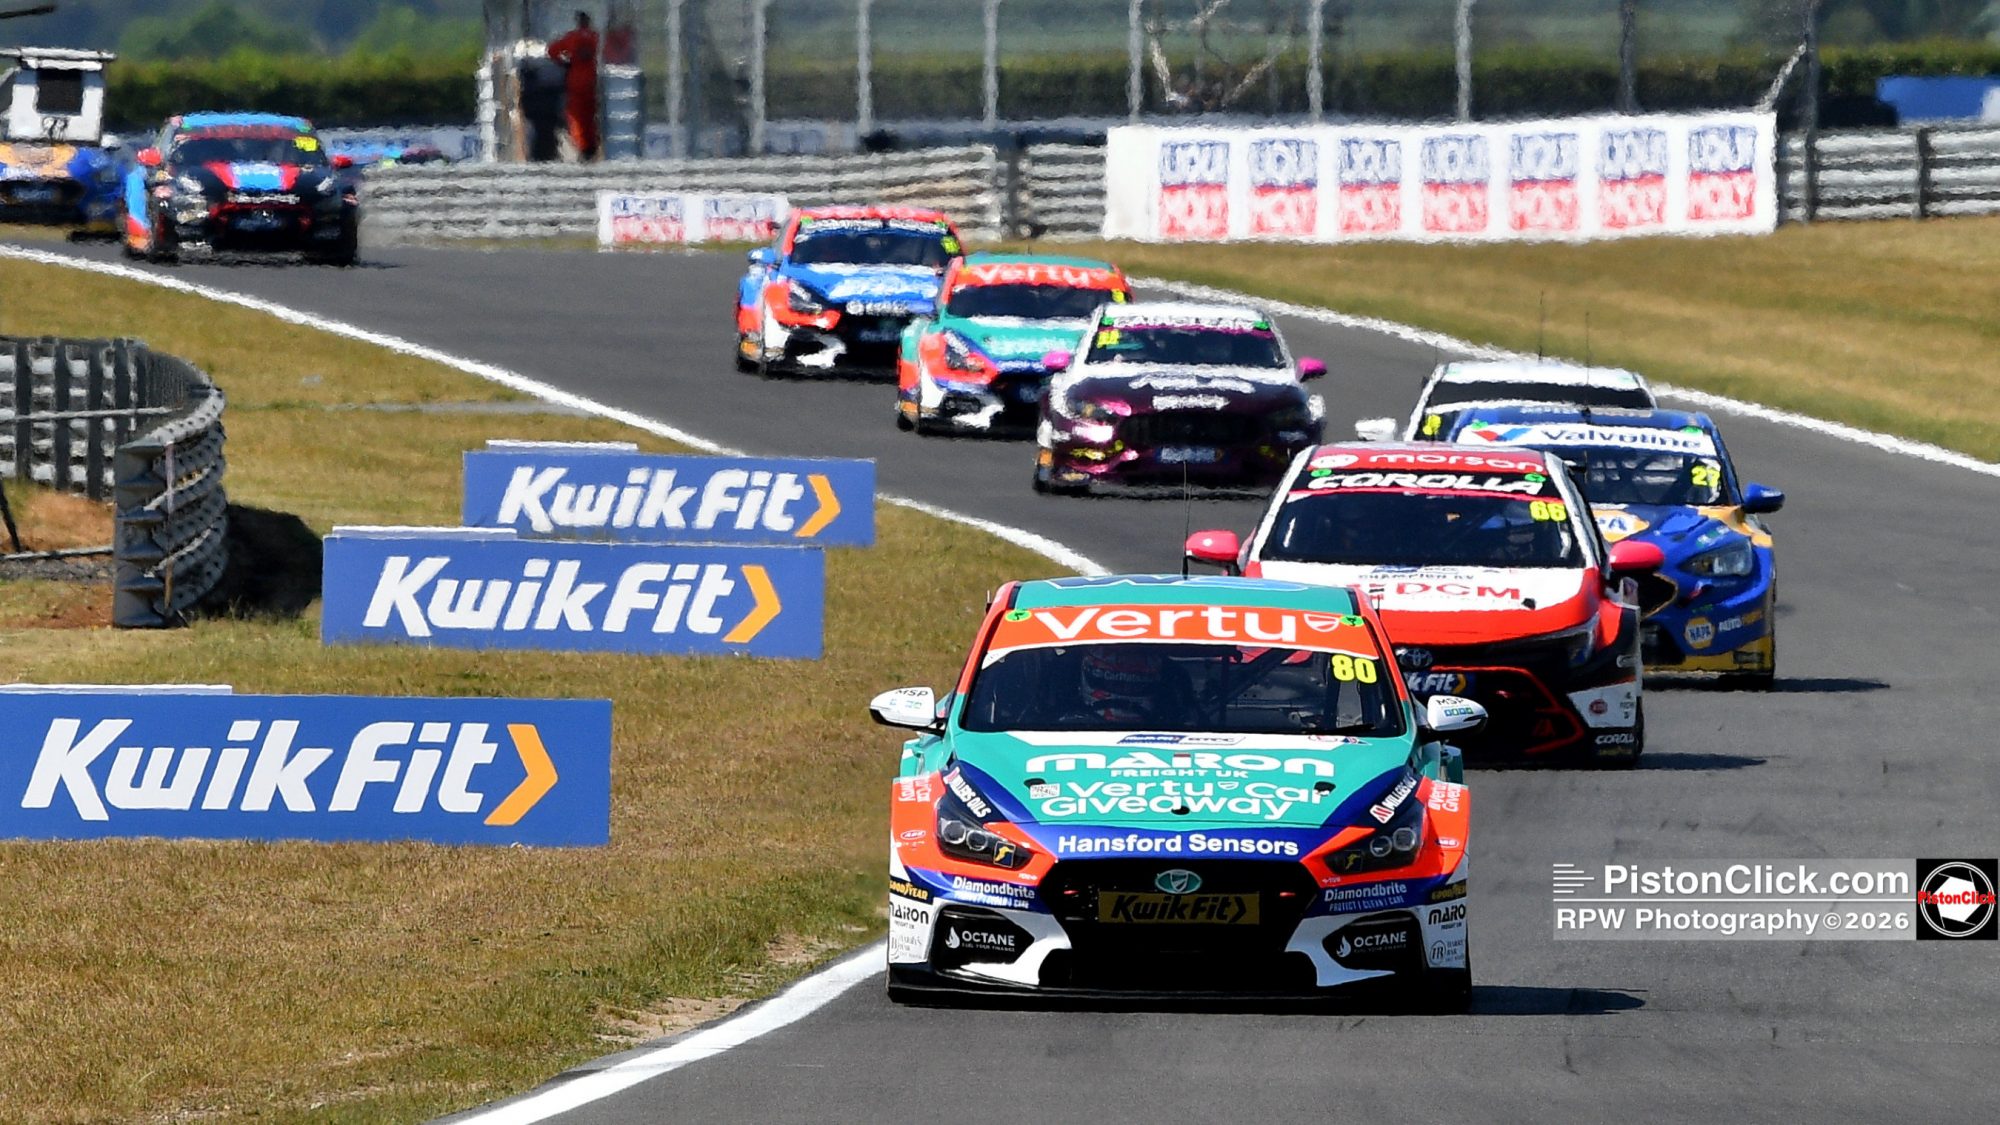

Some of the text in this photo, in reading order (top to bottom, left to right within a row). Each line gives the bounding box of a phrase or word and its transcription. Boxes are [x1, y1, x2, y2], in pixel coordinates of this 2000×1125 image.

[1540, 429, 1701, 449] Valvoline
[1370, 453, 1544, 472] morson
[1308, 473, 1543, 495] COROLLA
[1691, 466, 1720, 488] 27
[1530, 501, 1566, 522] 66
[1331, 655, 1377, 683] 80
[1111, 769, 1248, 778] FREIGHT UK
[1245, 782, 1330, 804] Car
[1381, 783, 1411, 810] MILLERS
[966, 796, 992, 818] OILS
[1041, 795, 1293, 820] Giveaway
[1058, 834, 1299, 855] Hansford Sensors
[953, 876, 1035, 899] Diamondbrite
[1324, 882, 1407, 901] Diamondbrite
[962, 931, 1015, 946] OCTANE
[1354, 931, 1407, 948] OCTANE
